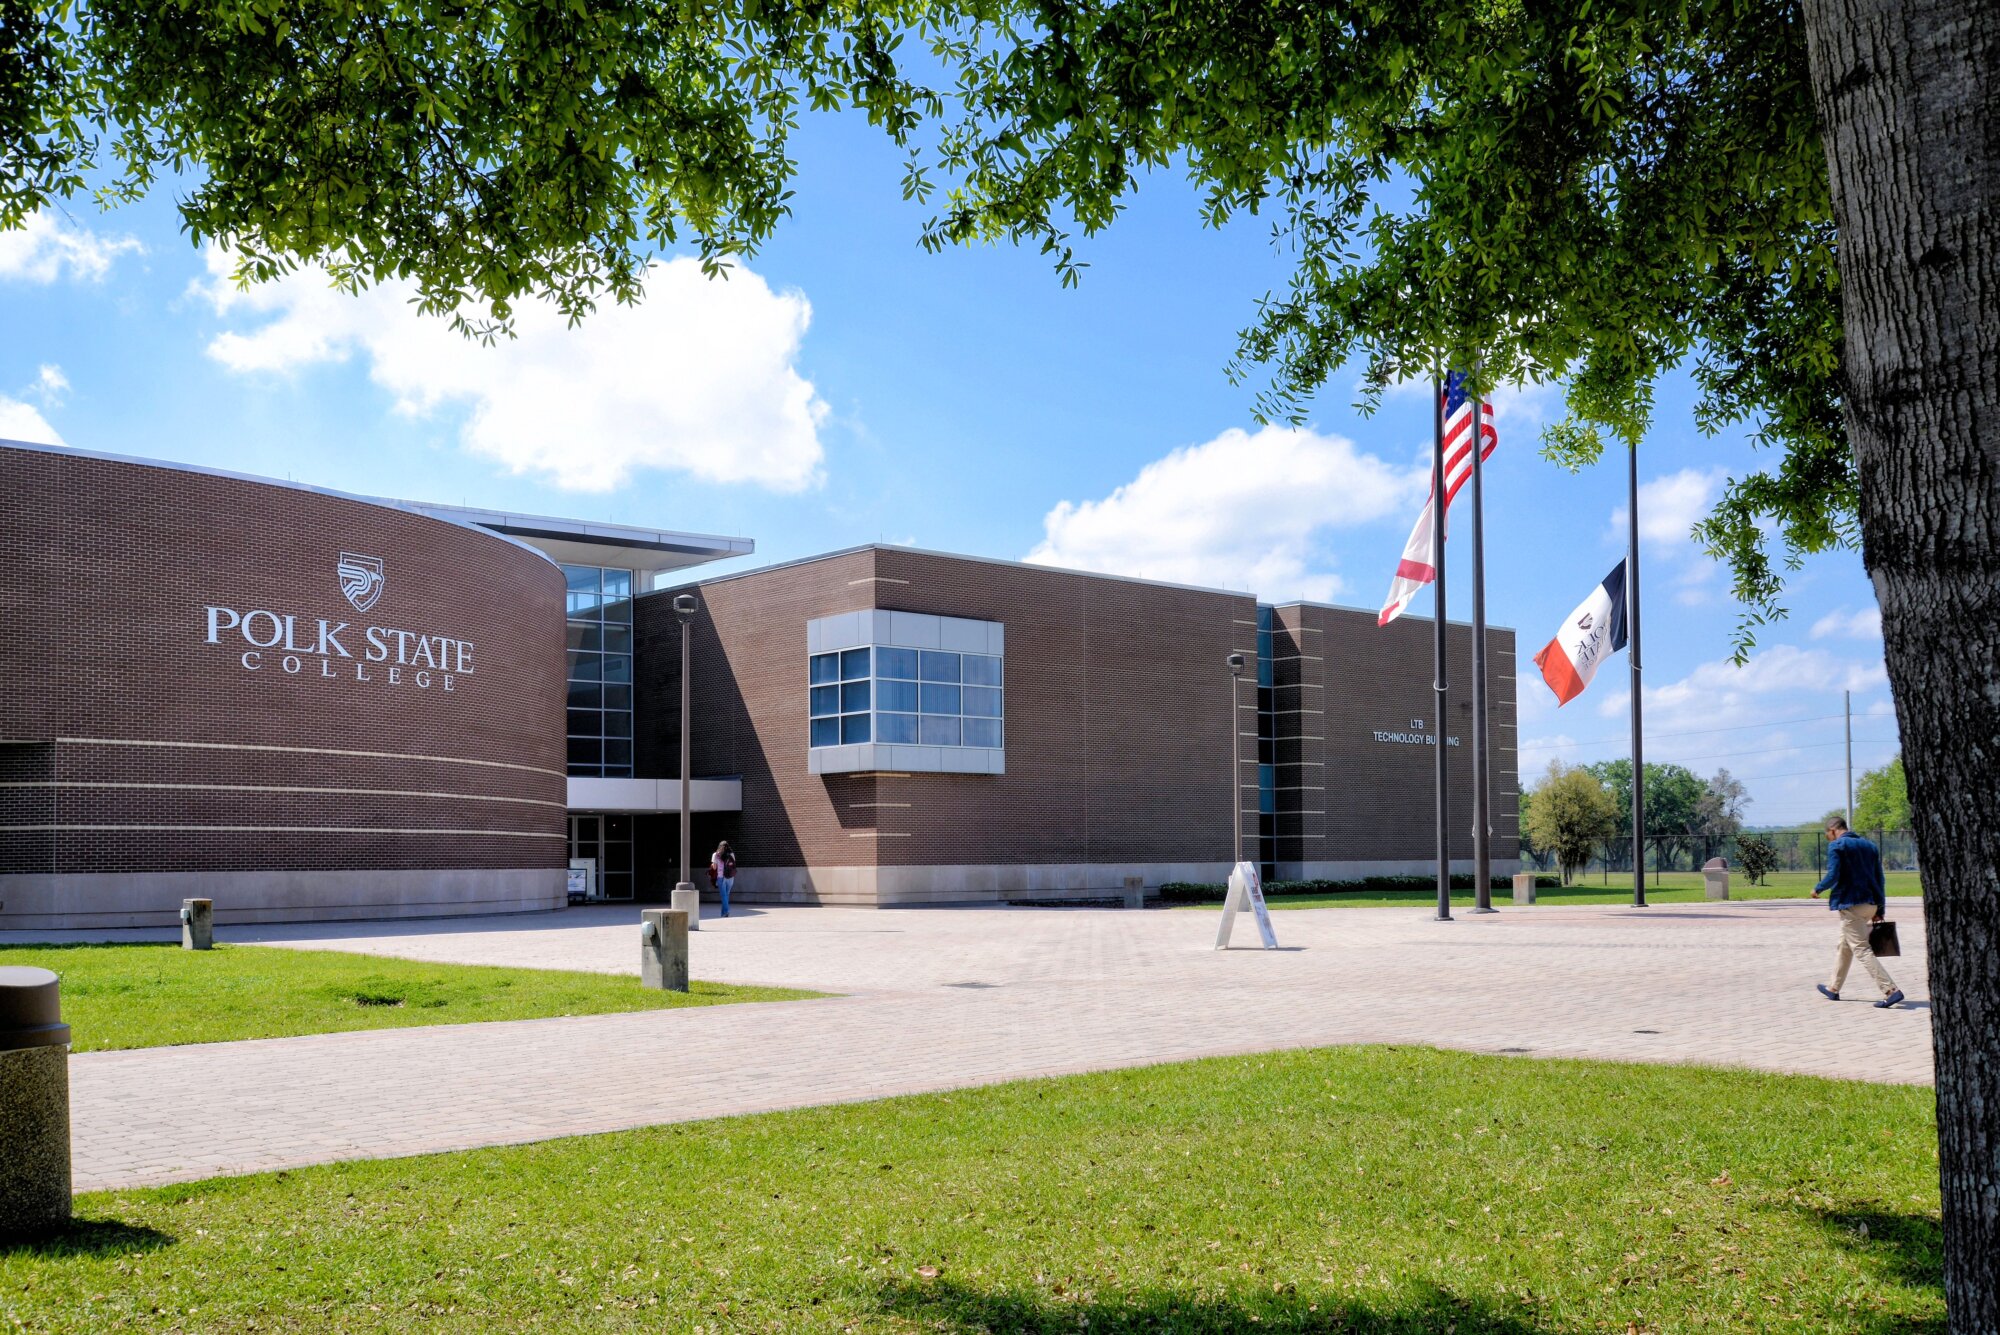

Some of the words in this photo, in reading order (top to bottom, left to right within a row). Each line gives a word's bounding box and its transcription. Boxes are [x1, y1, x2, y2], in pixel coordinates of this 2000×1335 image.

[203, 606, 353, 658] POLK
[365, 626, 475, 674] STATE
[241, 651, 455, 691] COLLEGE
[1410, 719, 1424, 729] LTB
[1373, 731, 1424, 744] TECHNOLOGY
[1426, 735, 1460, 747] BUING
